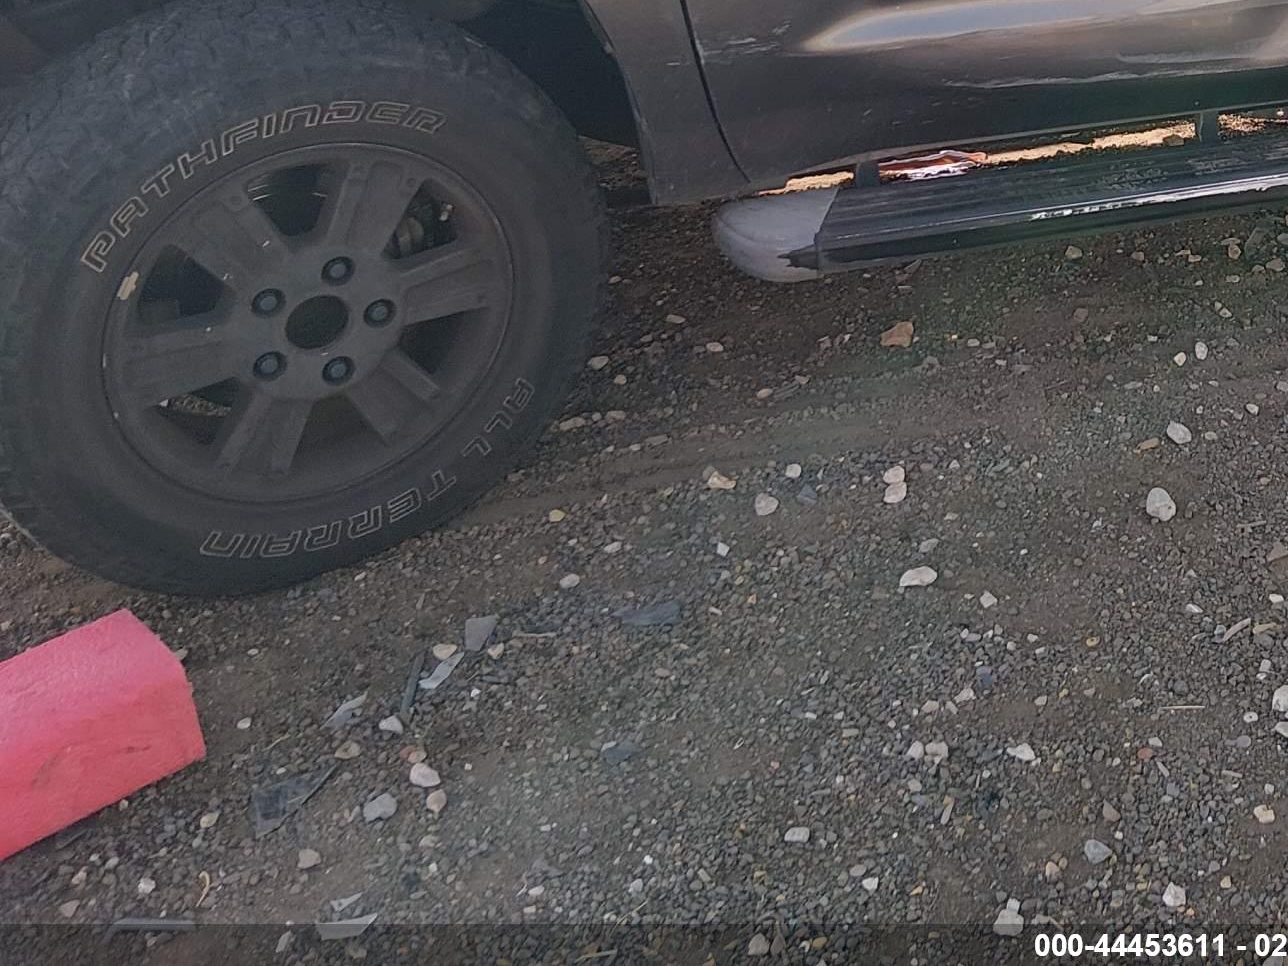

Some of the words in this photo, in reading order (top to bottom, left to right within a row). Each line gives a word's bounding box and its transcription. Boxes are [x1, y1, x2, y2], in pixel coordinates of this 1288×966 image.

[81, 100, 448, 273] PATHFINDER
[460, 377, 535, 459] ALL
[199, 468, 457, 559] TERRAIN
